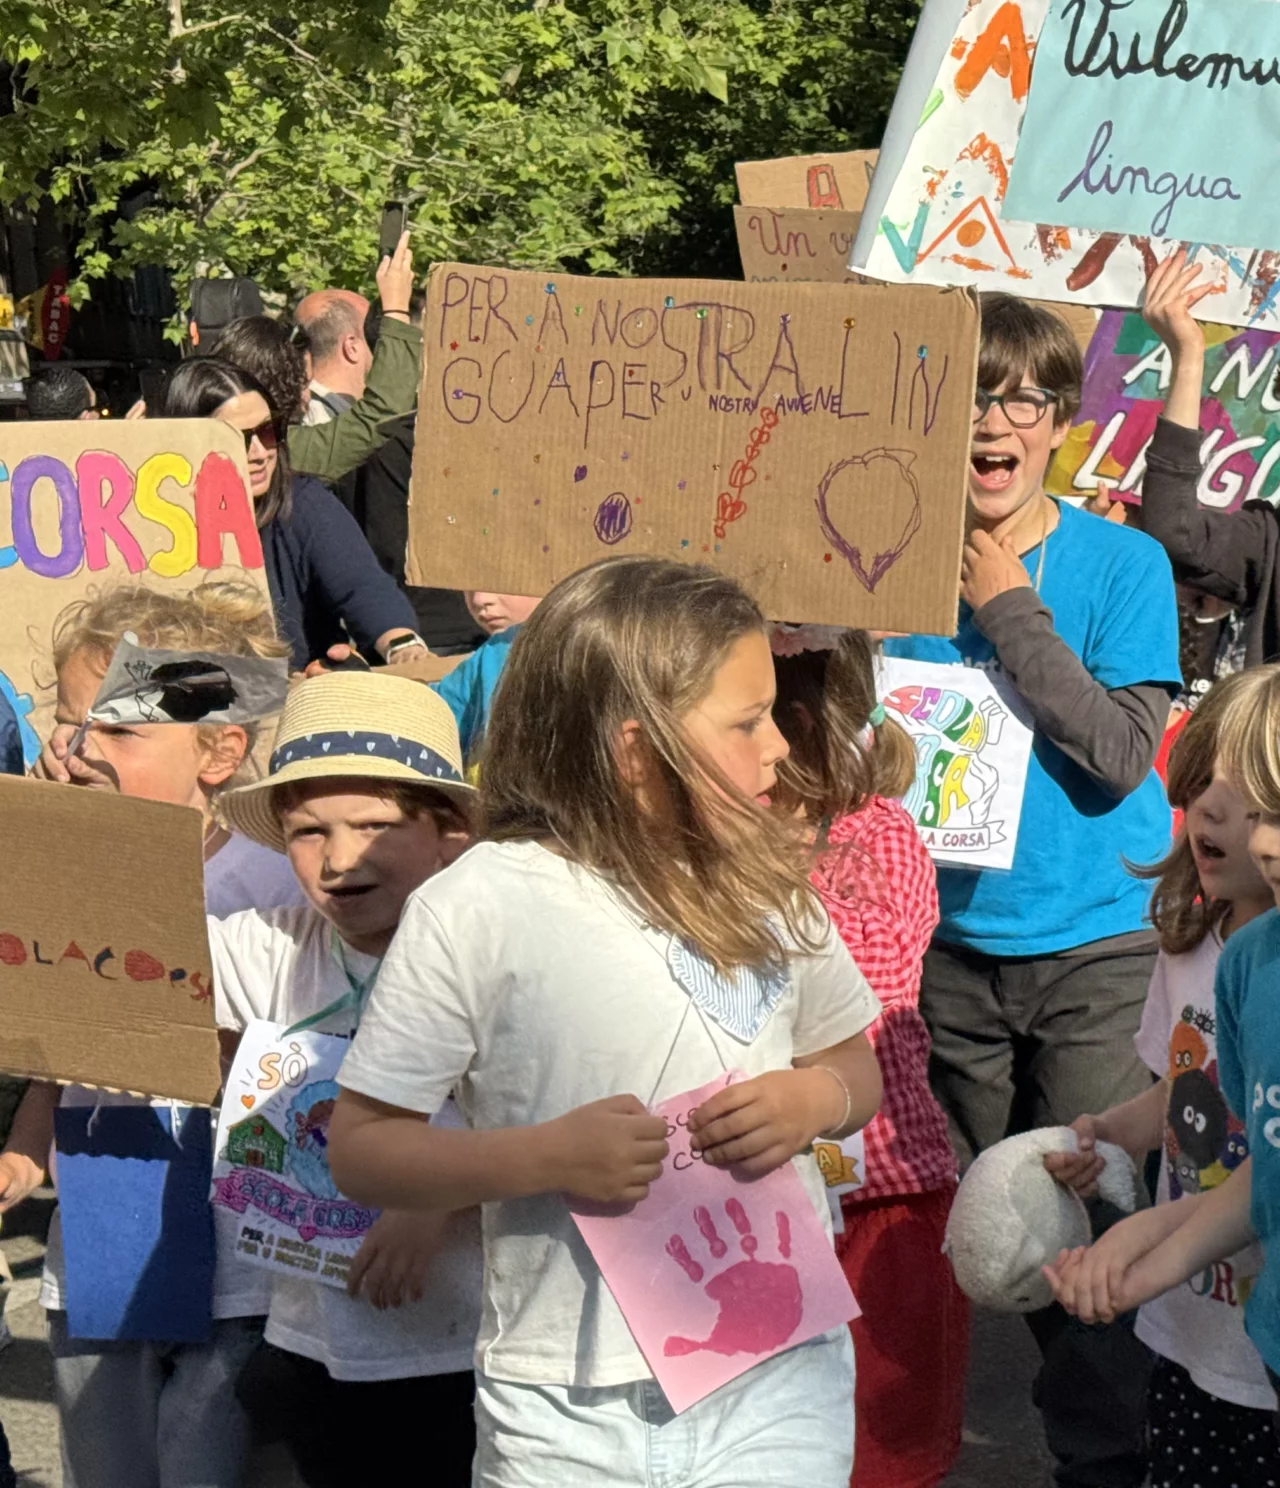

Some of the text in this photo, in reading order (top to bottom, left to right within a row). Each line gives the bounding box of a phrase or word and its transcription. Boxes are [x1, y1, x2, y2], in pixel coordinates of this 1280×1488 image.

[1057, 119, 1242, 237] lingua
[440, 272, 518, 348] PER
[0, 449, 265, 579] ORSA
[942, 832, 985, 848] CORSA
[257, 1041, 308, 1090] SÒ
